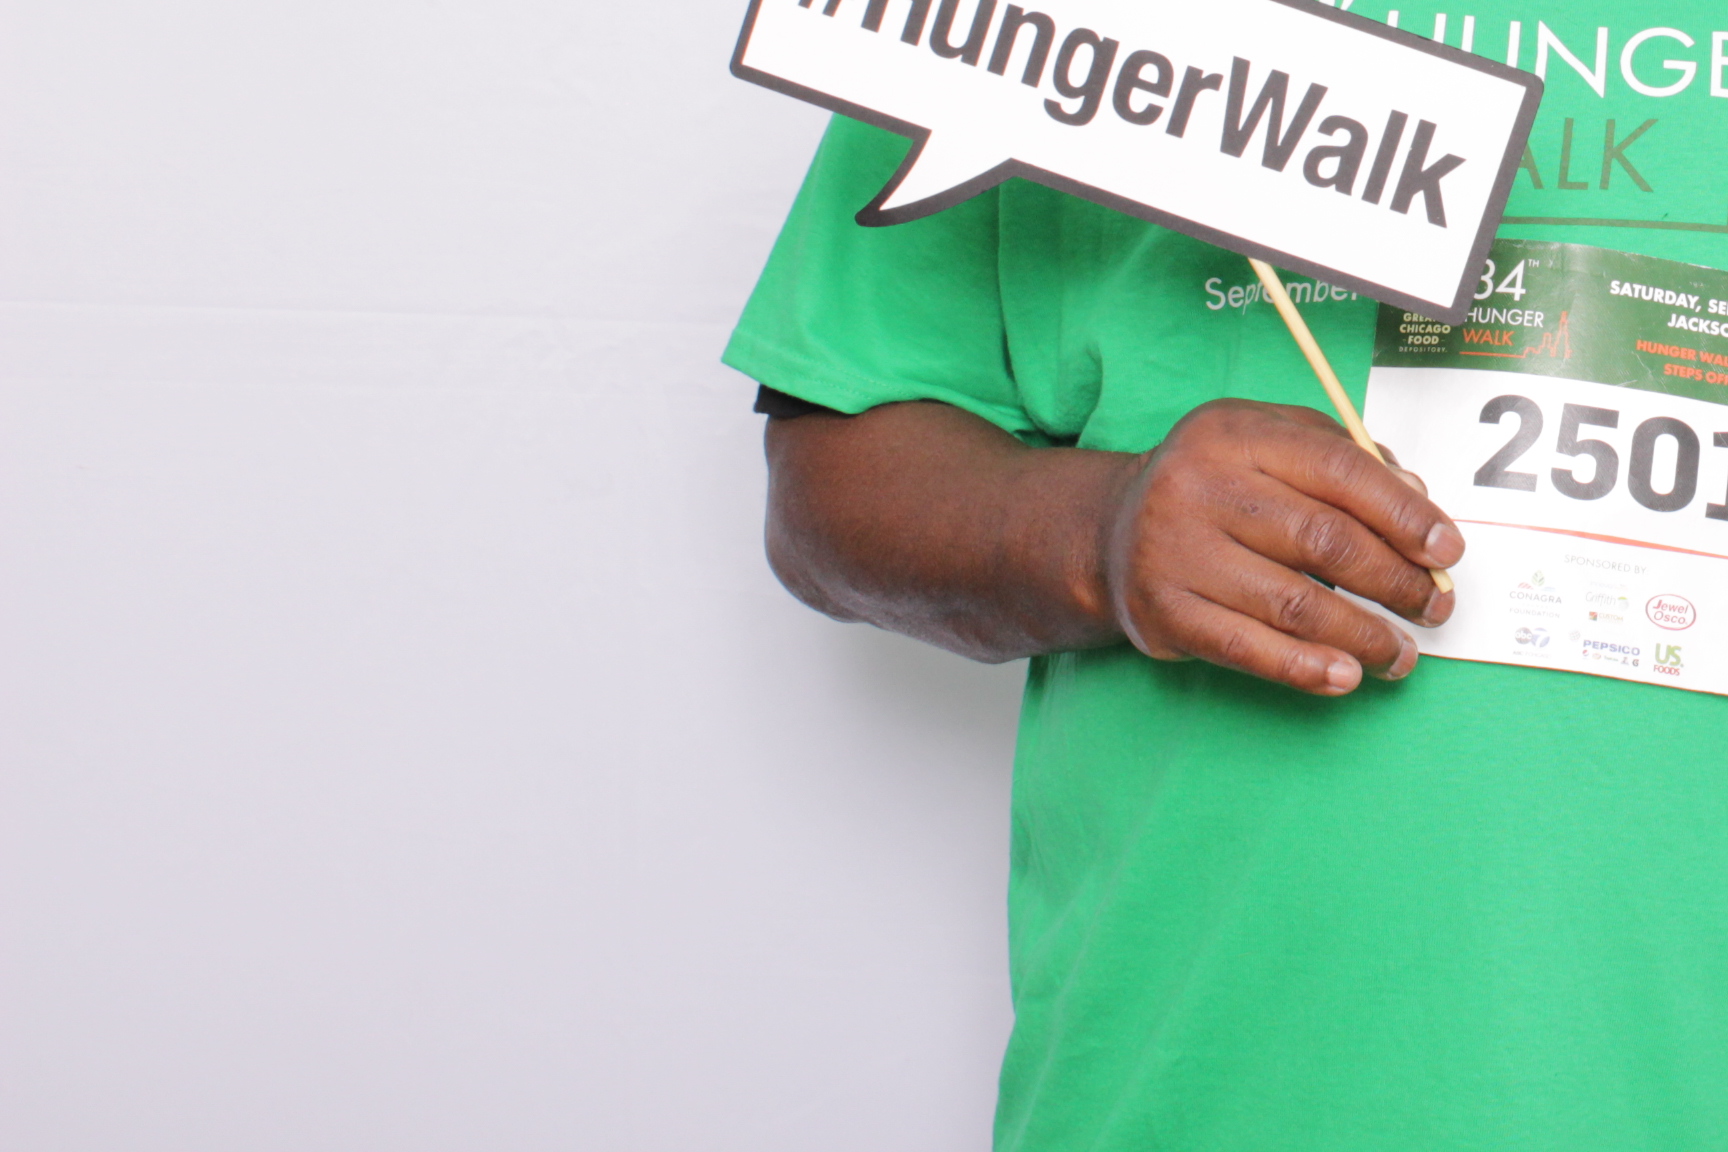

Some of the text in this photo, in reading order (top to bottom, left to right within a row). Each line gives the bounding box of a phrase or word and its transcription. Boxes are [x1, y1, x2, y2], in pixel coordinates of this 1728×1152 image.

[1205, 277, 1357, 316] Sepembe
[1610, 280, 1702, 312] SATURDAY,
[1464, 307, 1544, 328] HUNGER
[1399, 323, 1451, 334] CHICAGO
[1463, 328, 1516, 346] WALK
[1407, 335, 1440, 345] FOOD
[1636, 339, 1697, 361] HUNGER
[1663, 363, 1704, 381] STEPS
[1564, 554, 1631, 573] SPONSORED
[1509, 591, 1562, 604] CONAGRA
[1509, 607, 1561, 619] FOUNDATION
[1652, 599, 1689, 614] Jewel
[1583, 639, 1640, 656] PEPSICO
[1653, 664, 1680, 676] FOODS
